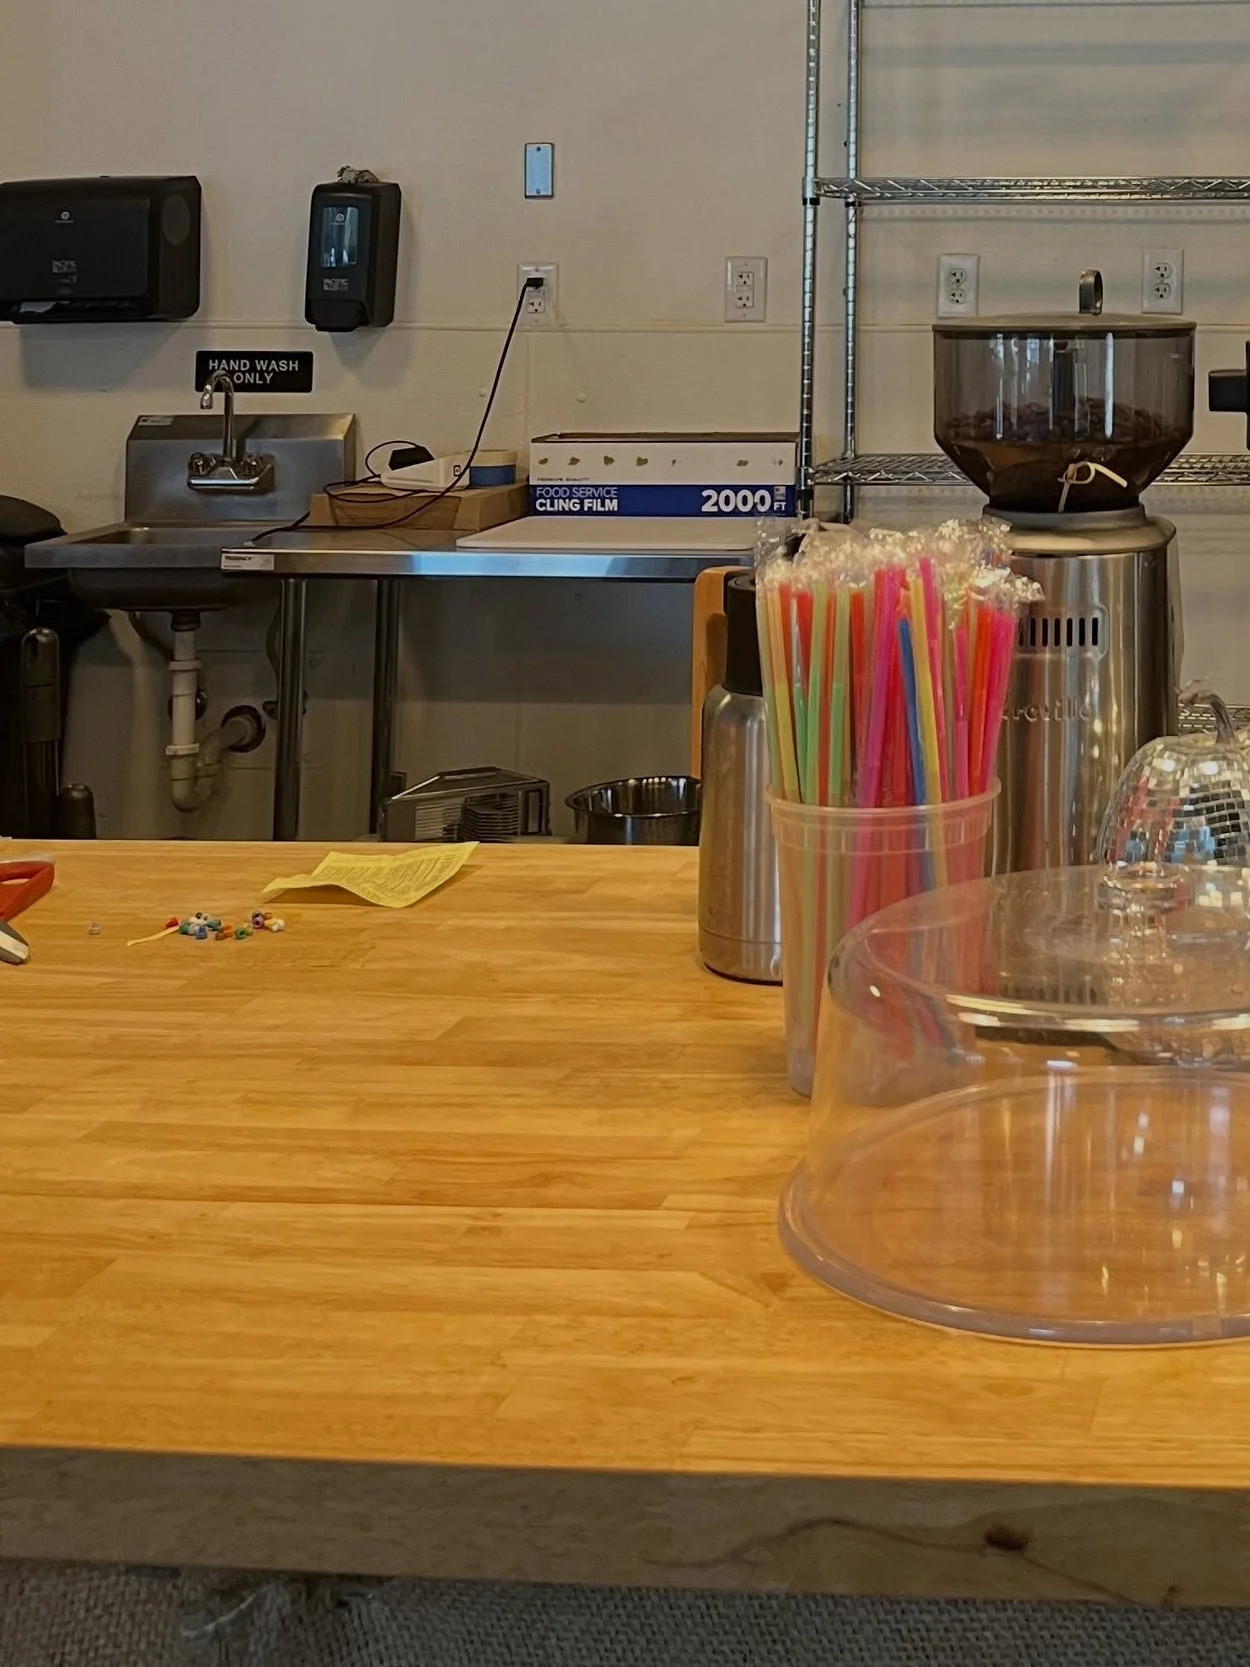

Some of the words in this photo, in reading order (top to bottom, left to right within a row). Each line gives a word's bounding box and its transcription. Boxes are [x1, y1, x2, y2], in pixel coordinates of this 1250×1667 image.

[208, 359, 250, 371] HAND
[255, 359, 299, 372] WASH
[233, 372, 274, 384] ONLY
[536, 487, 570, 498] FOOD
[572, 487, 618, 498] SERVICE
[535, 498, 580, 511] CLING
[583, 498, 618, 511] FILM
[701, 489, 771, 512] 2000
[773, 501, 787, 511] FT
